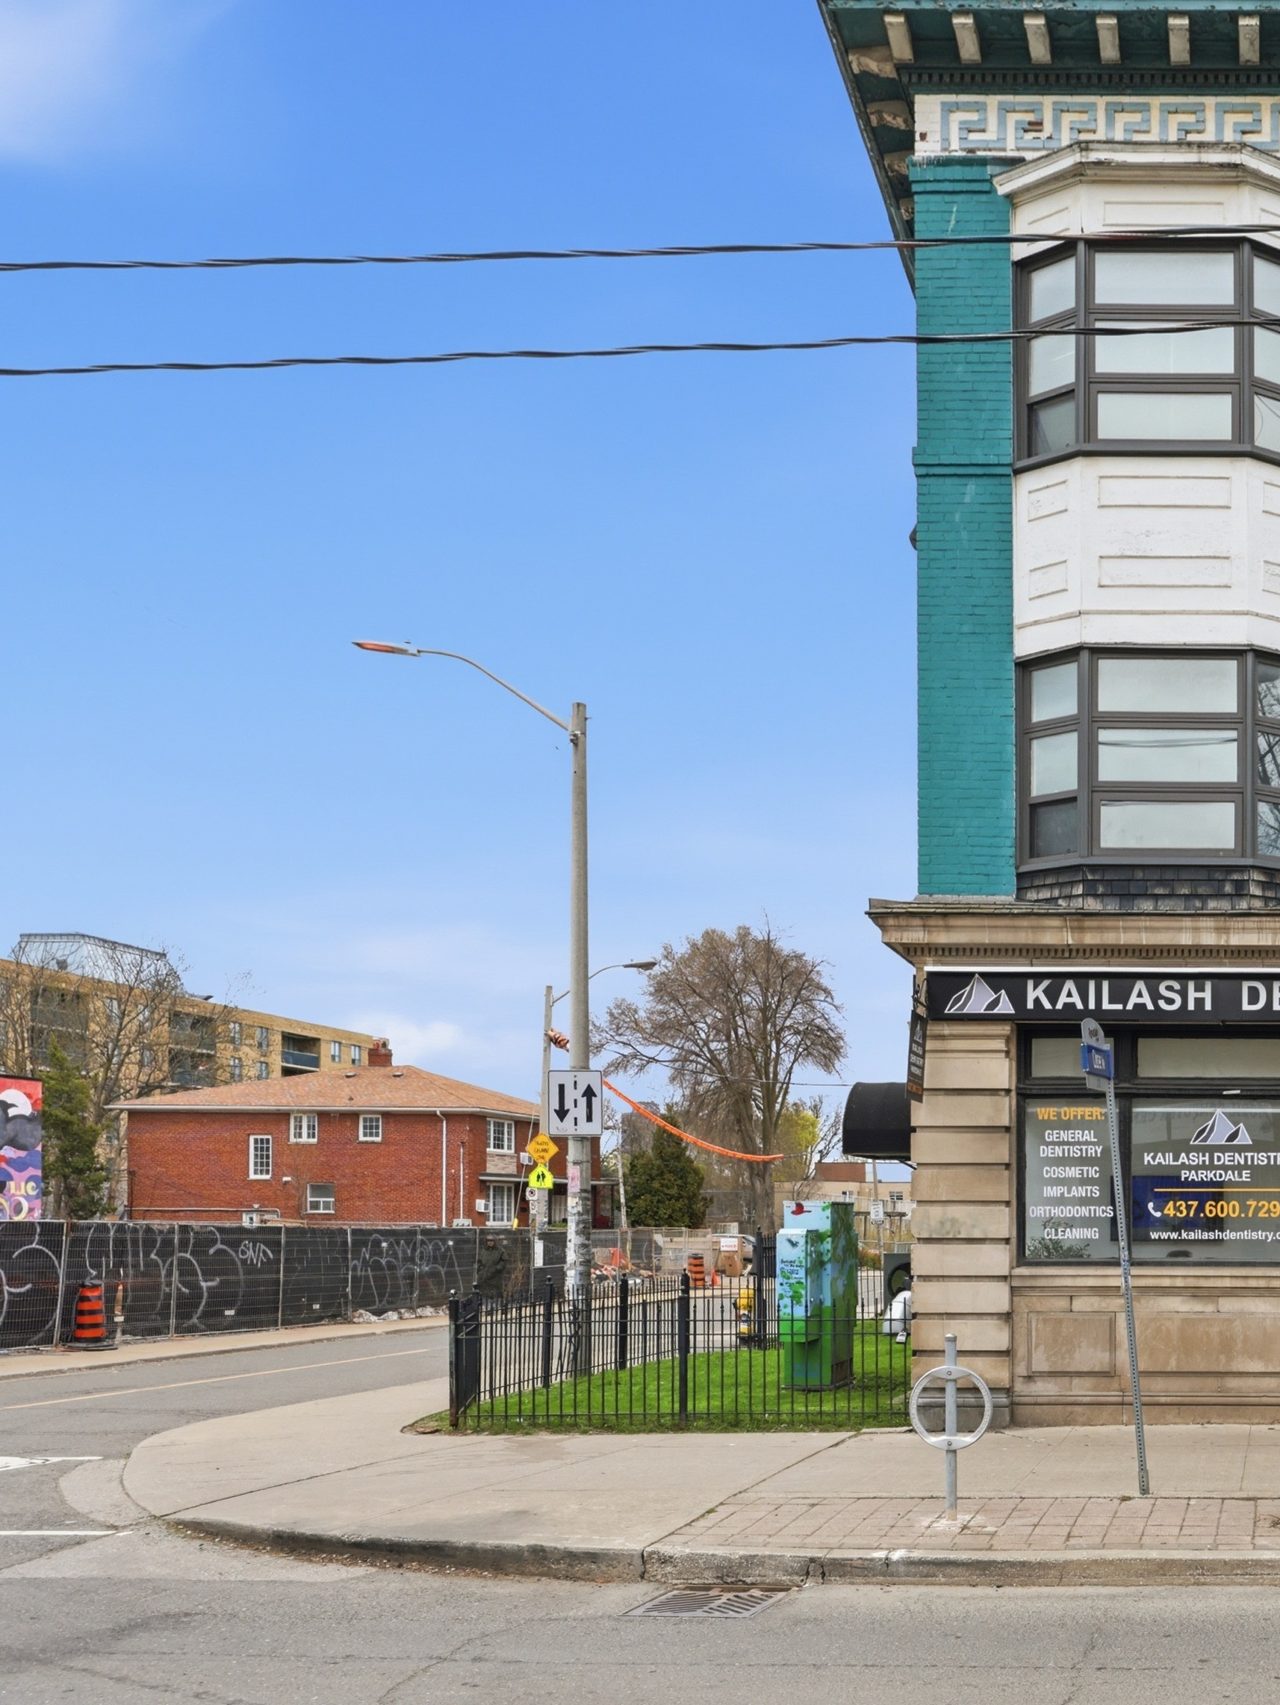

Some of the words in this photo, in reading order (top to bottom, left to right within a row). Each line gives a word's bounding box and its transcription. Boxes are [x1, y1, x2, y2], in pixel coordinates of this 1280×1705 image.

[1025, 979, 1212, 1012] KAILASH
[1036, 1106, 1058, 1121] WE
[1061, 1106, 1106, 1121] OFFER:
[1044, 1129, 1098, 1142] GENERAL
[1039, 1145, 1103, 1158] DENTISTRY
[1143, 1152, 1210, 1166] KAILASH
[1043, 1165, 1100, 1178] COSMETIC
[1180, 1170, 1251, 1182] PARKDALE
[1043, 1185, 1100, 1198] IMPLANTS
[1029, 1205, 1115, 1218] ORTHODONTICS
[1044, 1227, 1099, 1240] CLEANING
